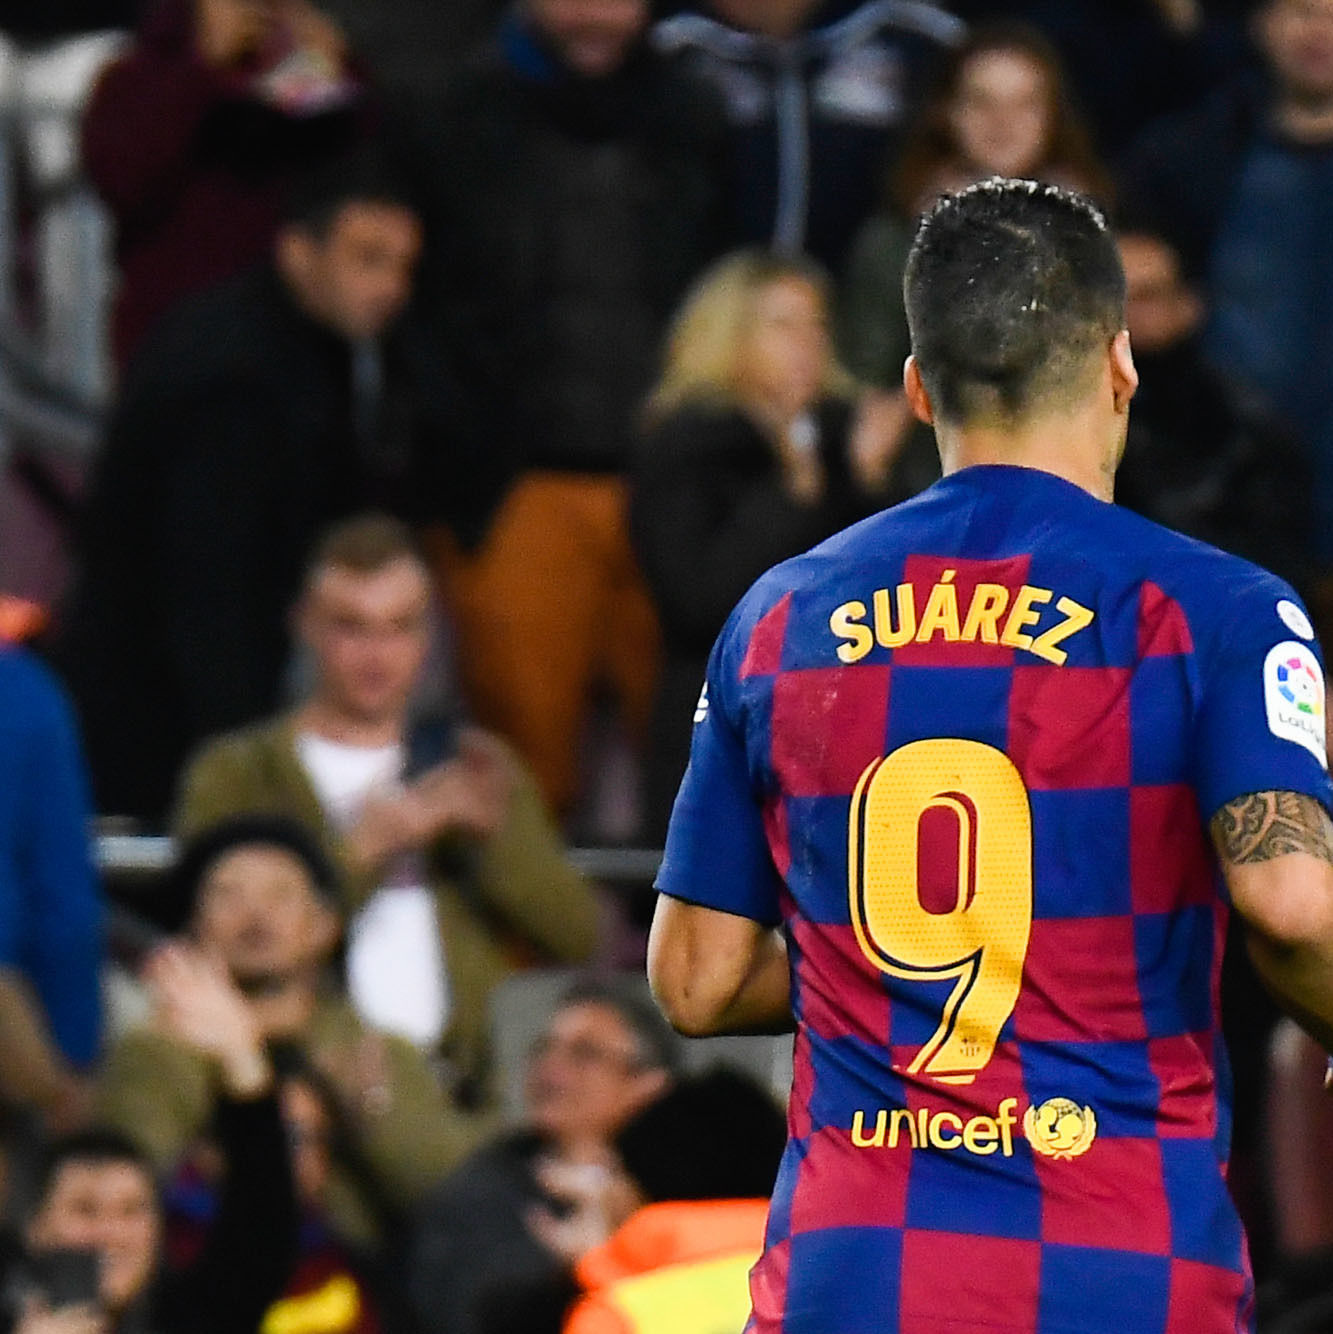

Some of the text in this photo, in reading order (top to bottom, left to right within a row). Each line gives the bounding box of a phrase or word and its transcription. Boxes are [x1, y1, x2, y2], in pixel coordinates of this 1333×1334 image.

[829, 570, 1093, 666] SUÁREZ
[848, 738, 1032, 1085] 9
[850, 1098, 1018, 1157] unicef
